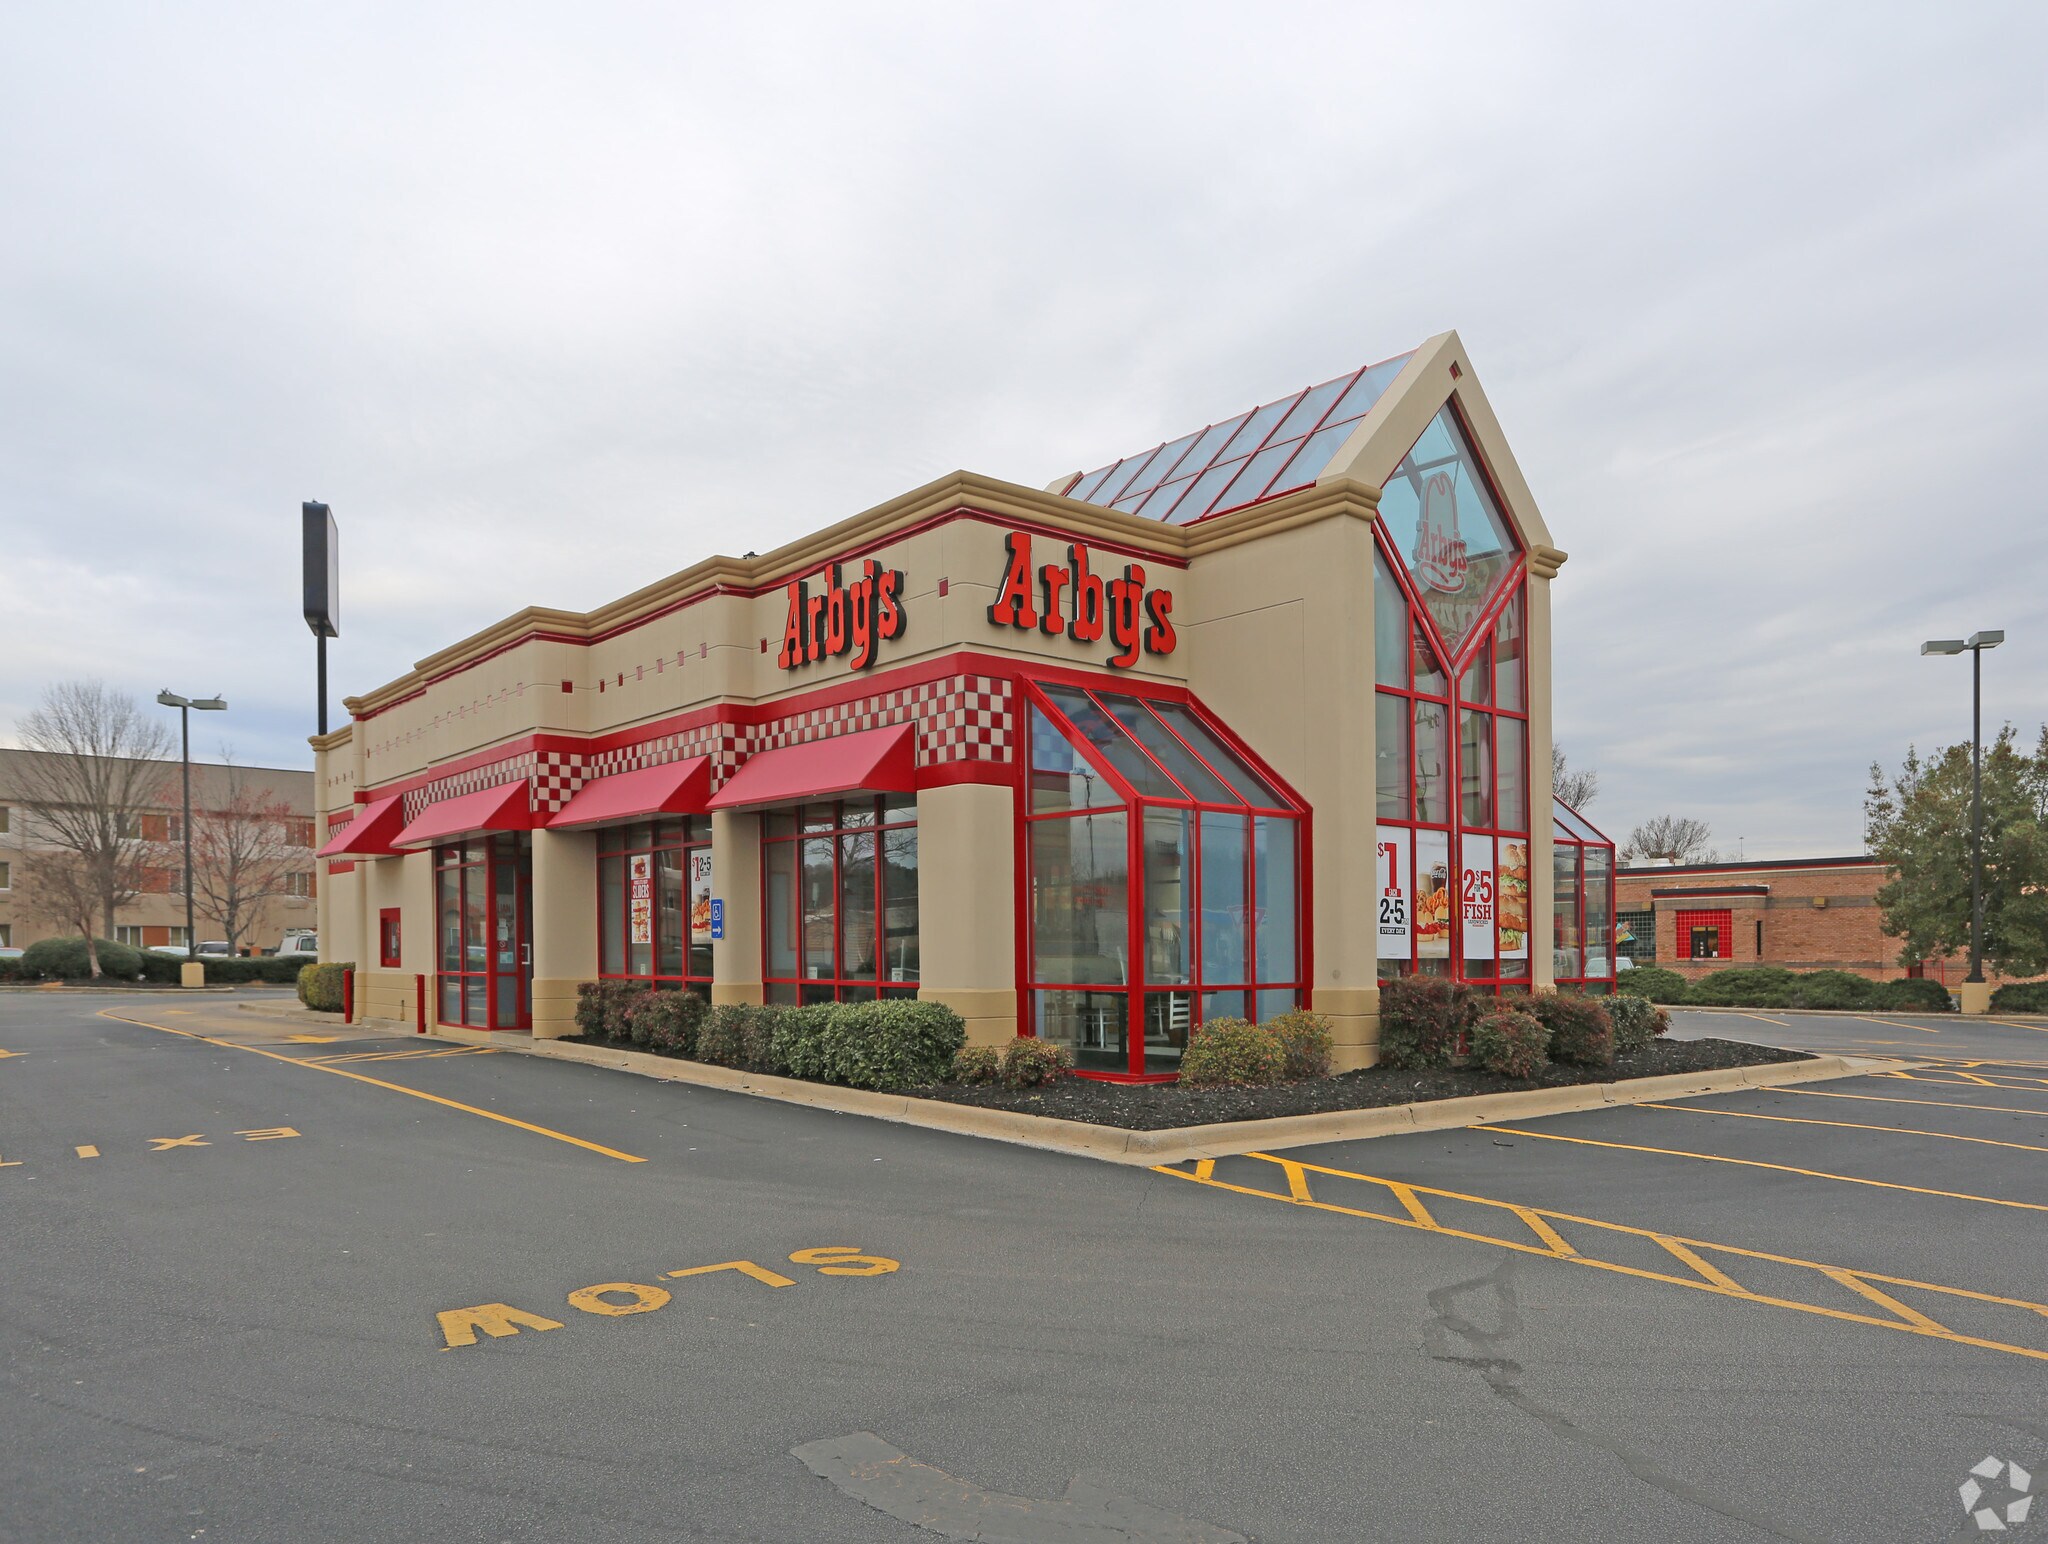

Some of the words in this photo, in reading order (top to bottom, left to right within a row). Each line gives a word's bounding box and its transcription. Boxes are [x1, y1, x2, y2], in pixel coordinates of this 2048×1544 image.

[1417, 520, 1468, 578] Arby's
[778, 559, 906, 670] Arby's
[987, 531, 1177, 668] Arby's
[633, 884, 649, 899] SLIDERS
[1377, 842, 1400, 896] $1
[1463, 903, 1492, 920] FISH
[436, 1246, 900, 1349] SLOW
